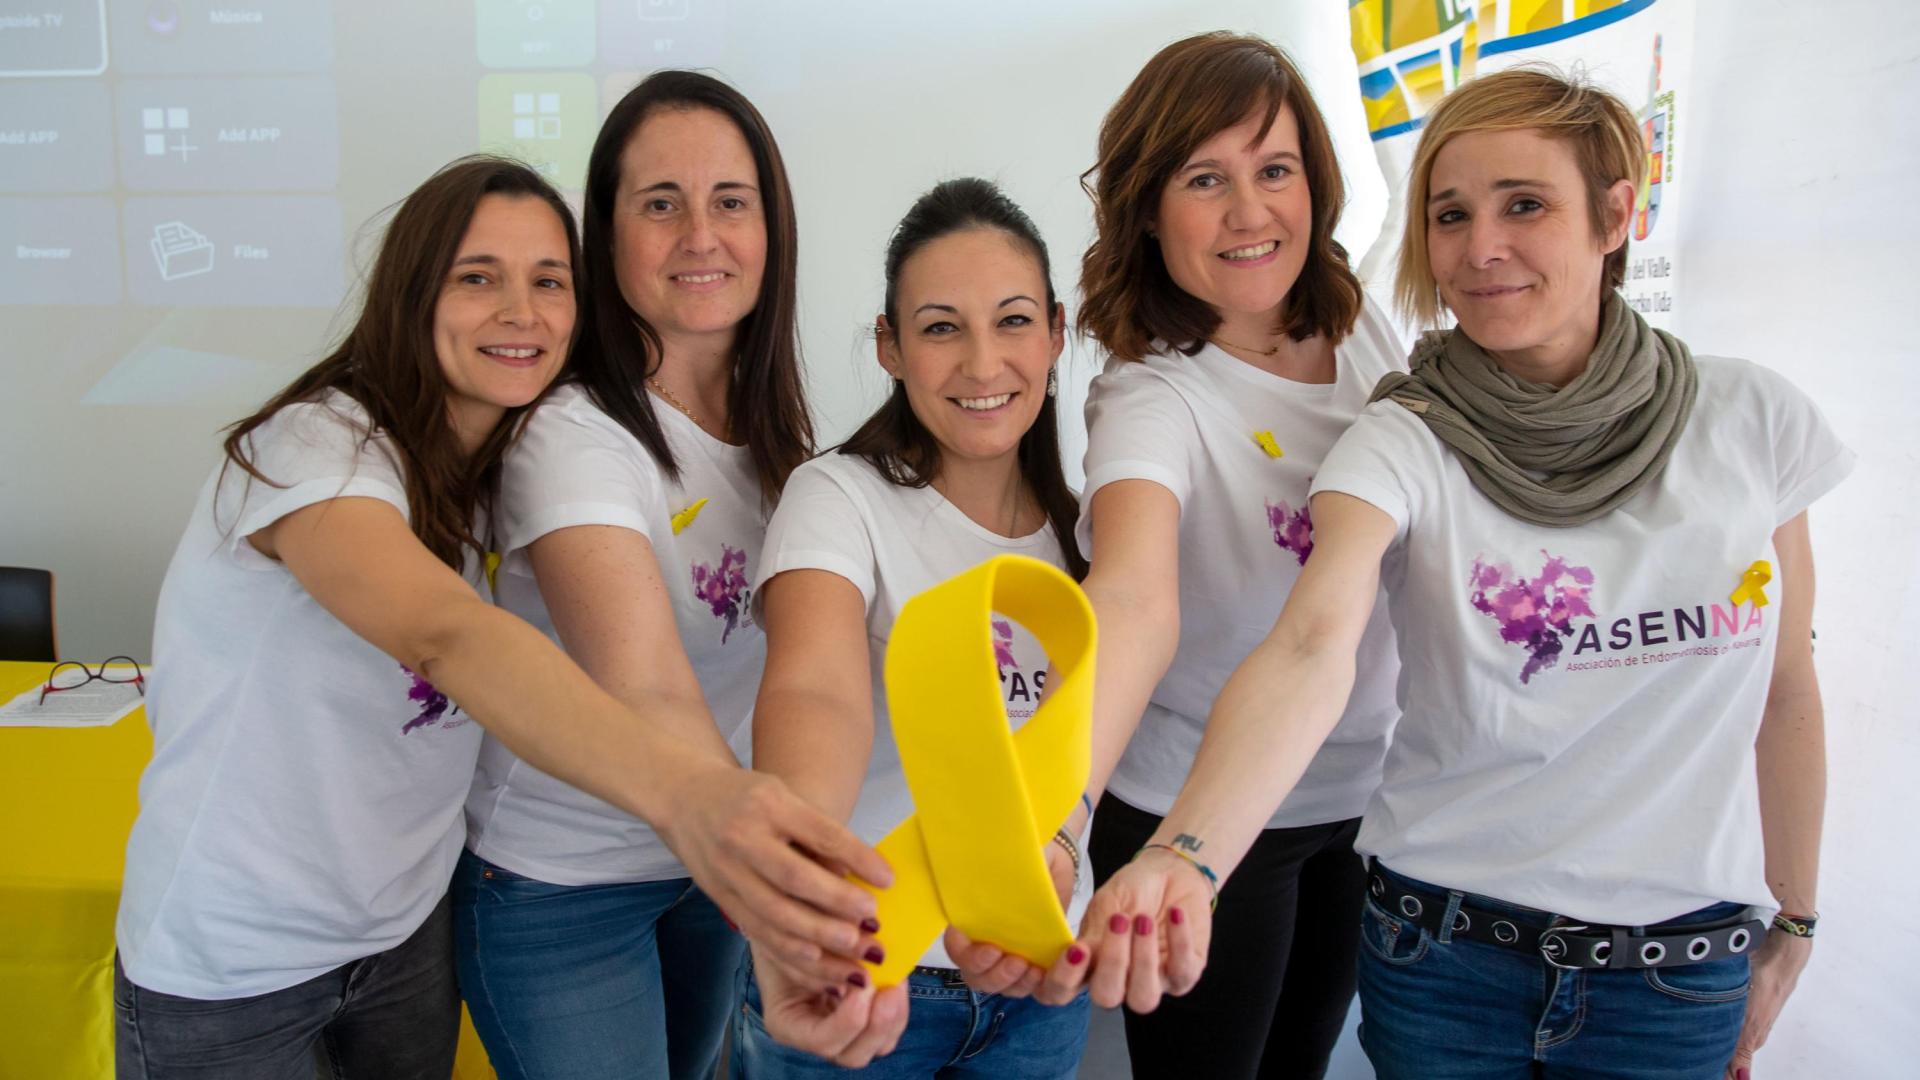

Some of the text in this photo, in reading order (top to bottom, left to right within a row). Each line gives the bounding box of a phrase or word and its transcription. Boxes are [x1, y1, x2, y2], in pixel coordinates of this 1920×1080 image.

[44, 13, 63, 27] TV
[28, 131, 59, 144] APP
[217, 128, 281, 142] Add APP
[16, 245, 72, 259] Browser
[233, 245, 269, 260] Files
[1573, 602, 1763, 655] ASENNA
[1624, 654, 1639, 667] de
